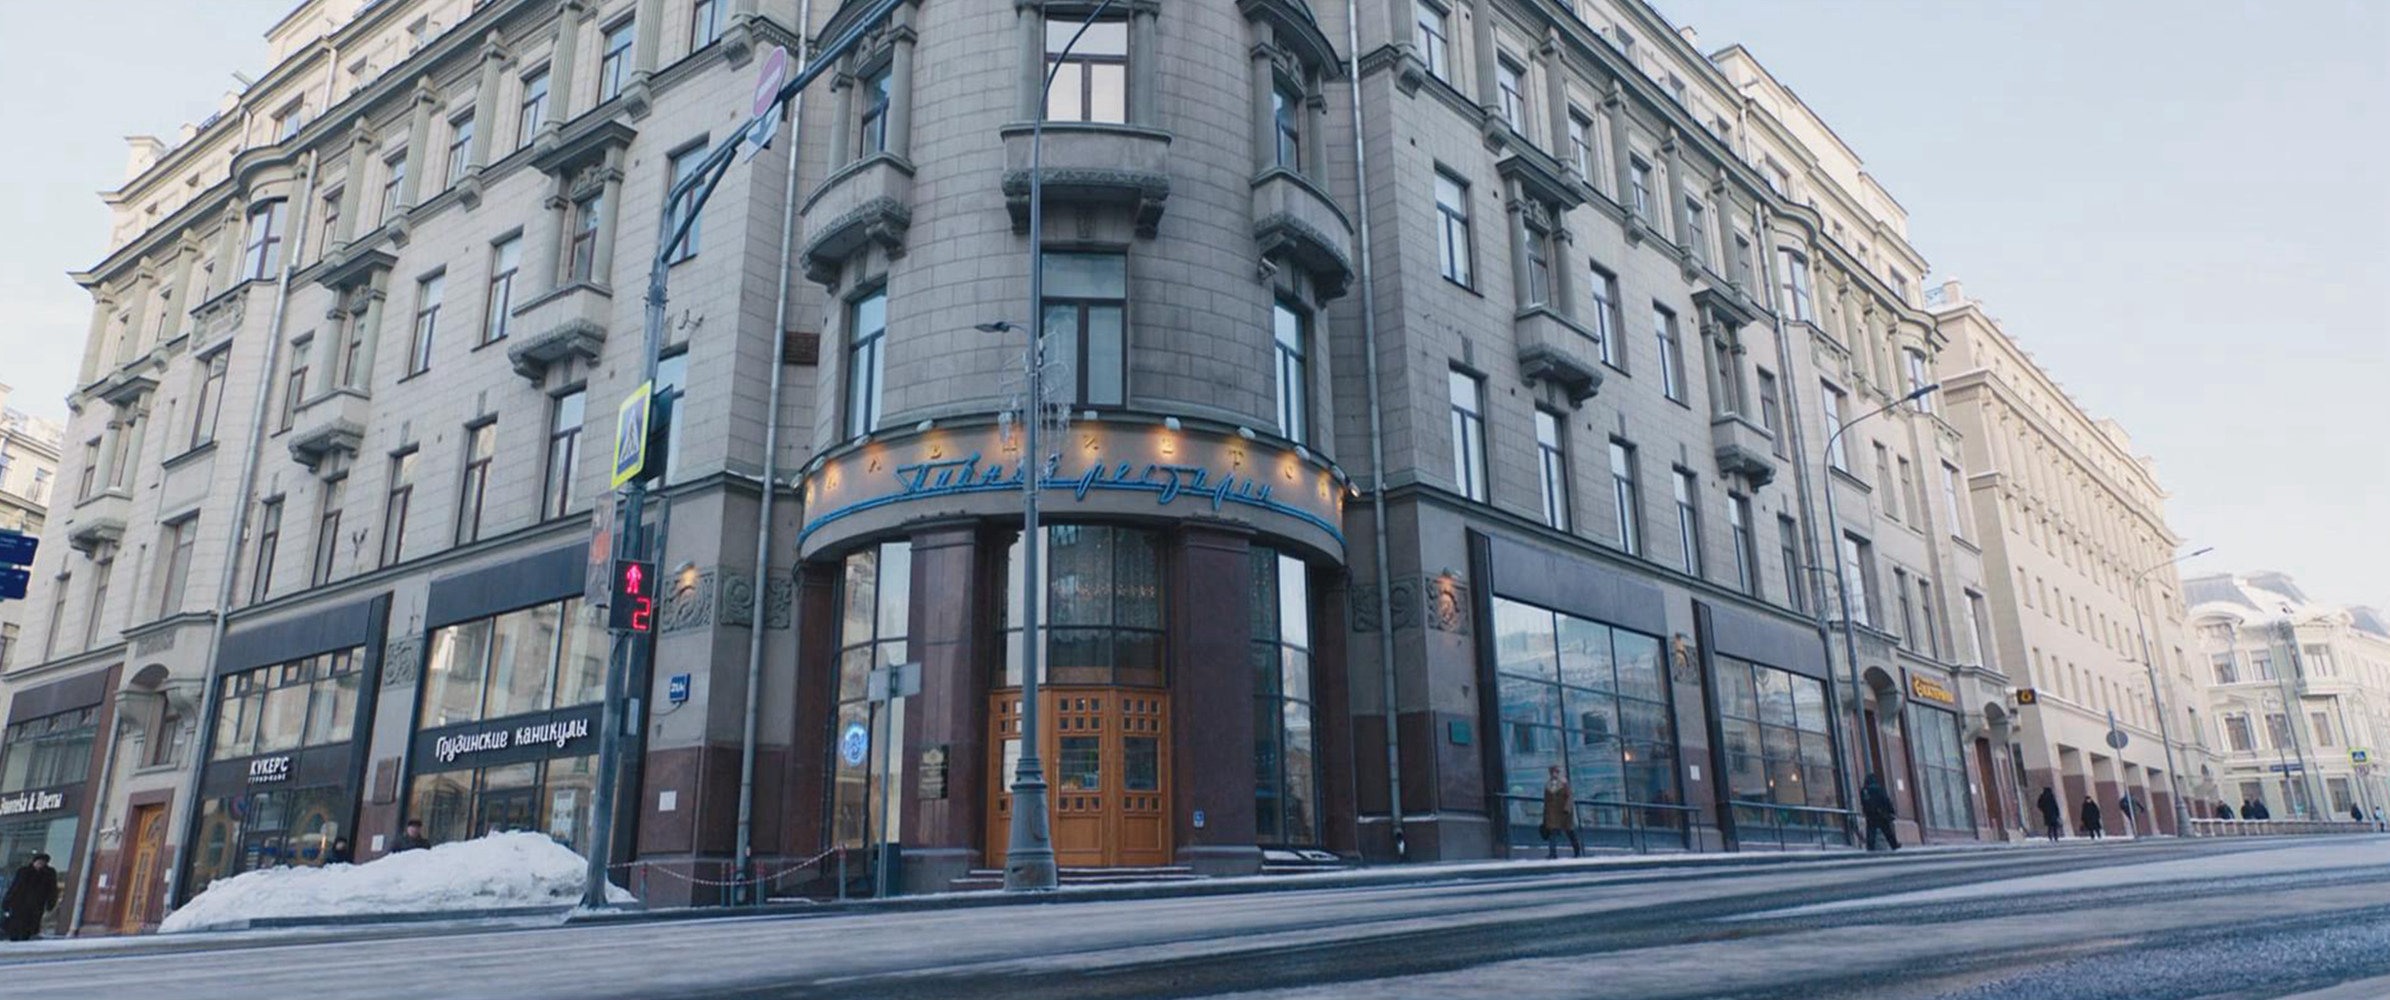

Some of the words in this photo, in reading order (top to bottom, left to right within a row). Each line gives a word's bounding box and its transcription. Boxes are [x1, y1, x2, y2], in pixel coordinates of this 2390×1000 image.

[632, 596, 651, 631] 2
[435, 730, 509, 763] Грузинские
[515, 717, 588, 748] каникулы
